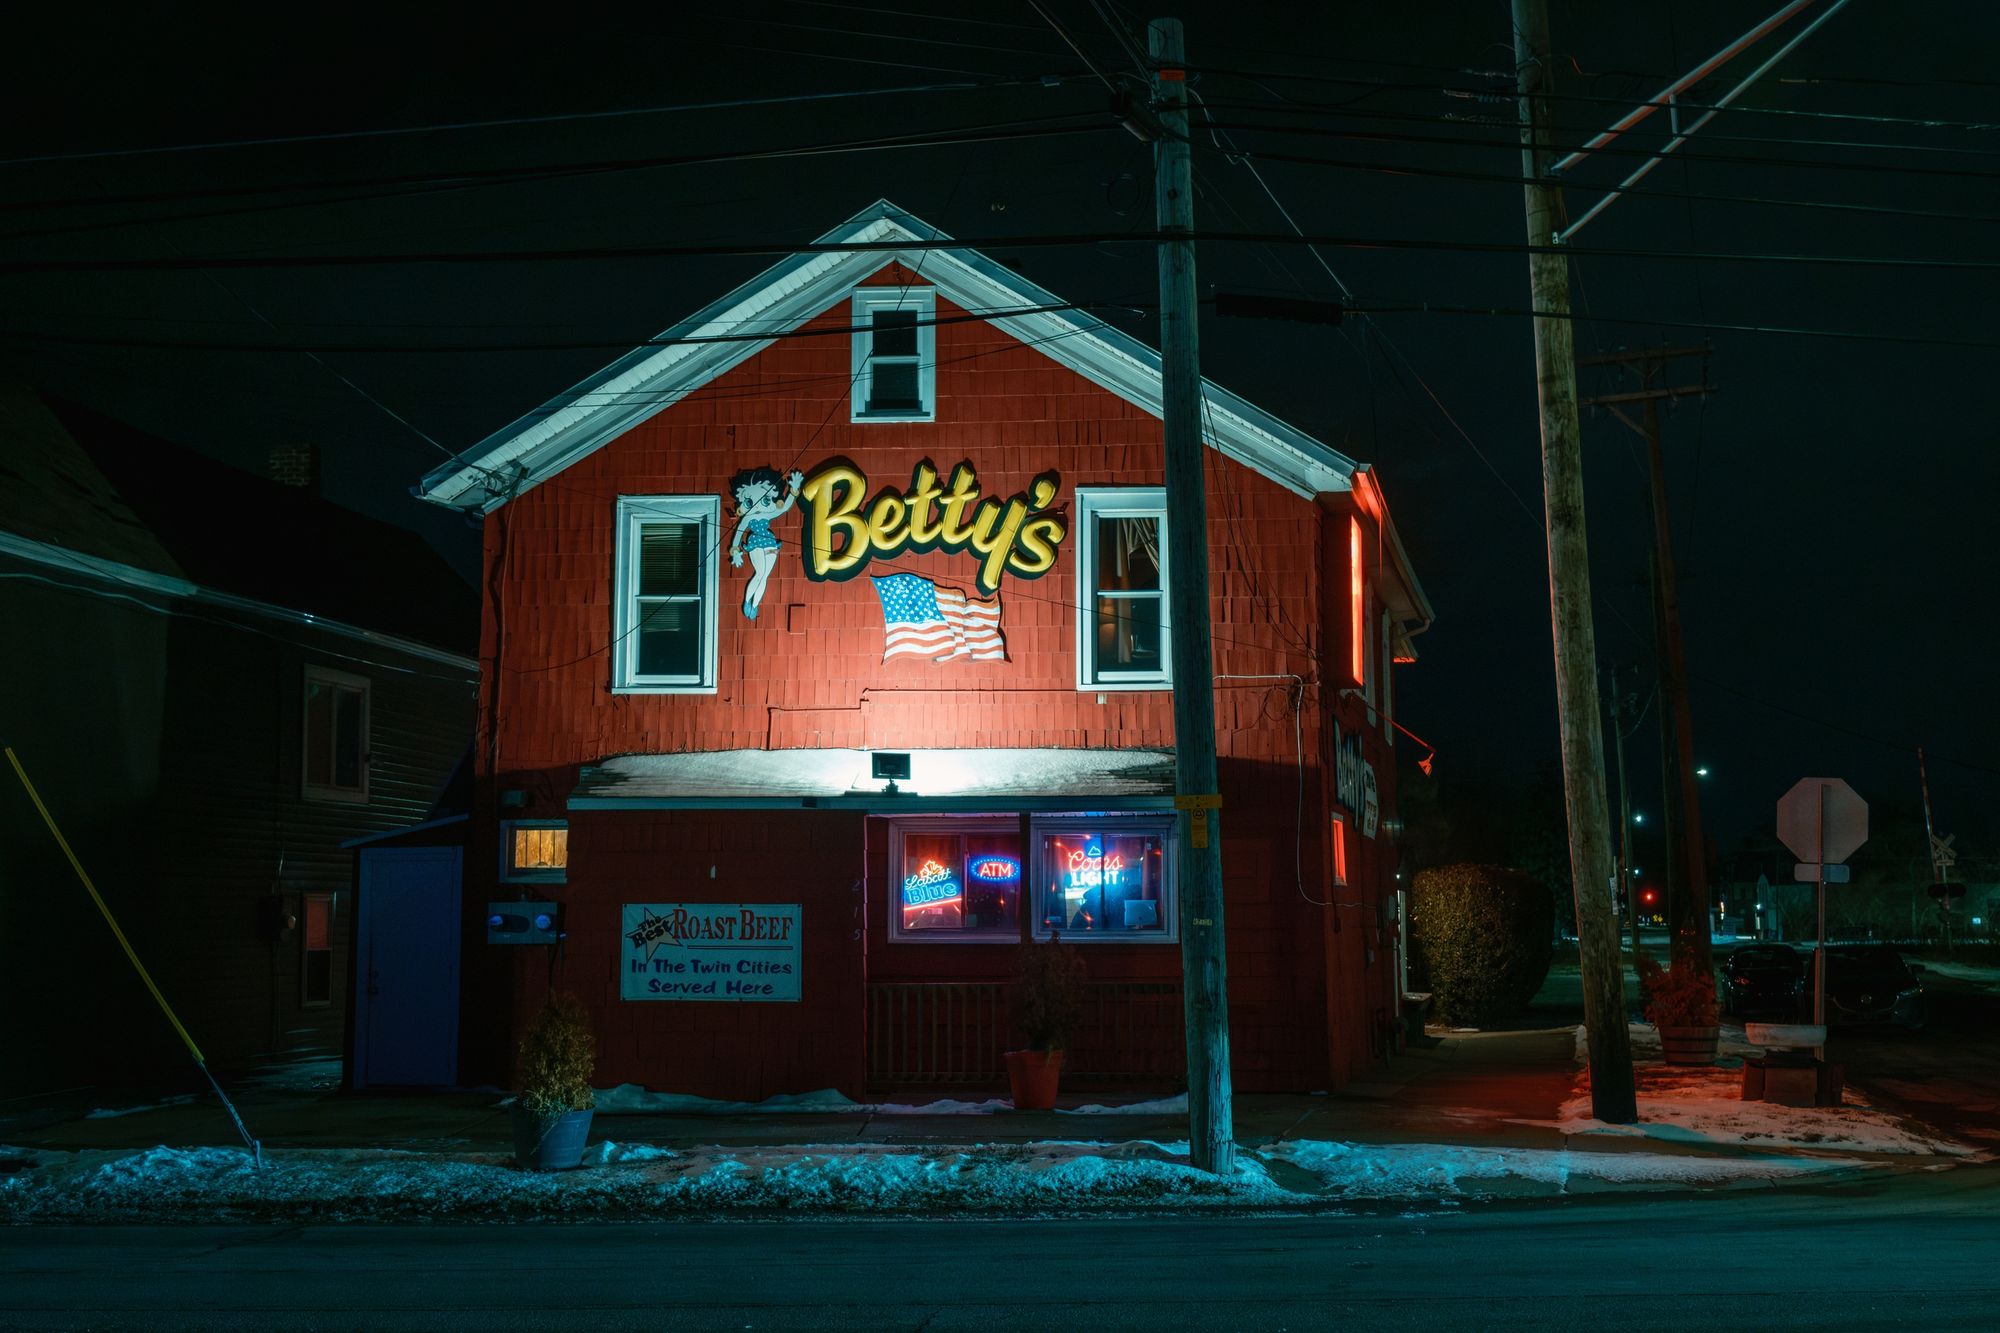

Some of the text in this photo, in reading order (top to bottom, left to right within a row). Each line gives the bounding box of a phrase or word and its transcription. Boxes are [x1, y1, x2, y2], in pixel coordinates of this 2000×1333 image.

[802, 459, 1066, 594] Betty's
[980, 863, 1011, 877] ATM
[1068, 851, 1123, 871] Coors
[905, 867, 951, 889] Labatt
[1071, 871, 1119, 886] LIGHT
[907, 883, 957, 905] Blue
[632, 920, 671, 948] Best
[638, 916, 661, 932] The
[672, 908, 793, 940] ROAST BEEF
[631, 958, 792, 974] In The Twin Cities
[648, 978, 773, 995] Served Here
